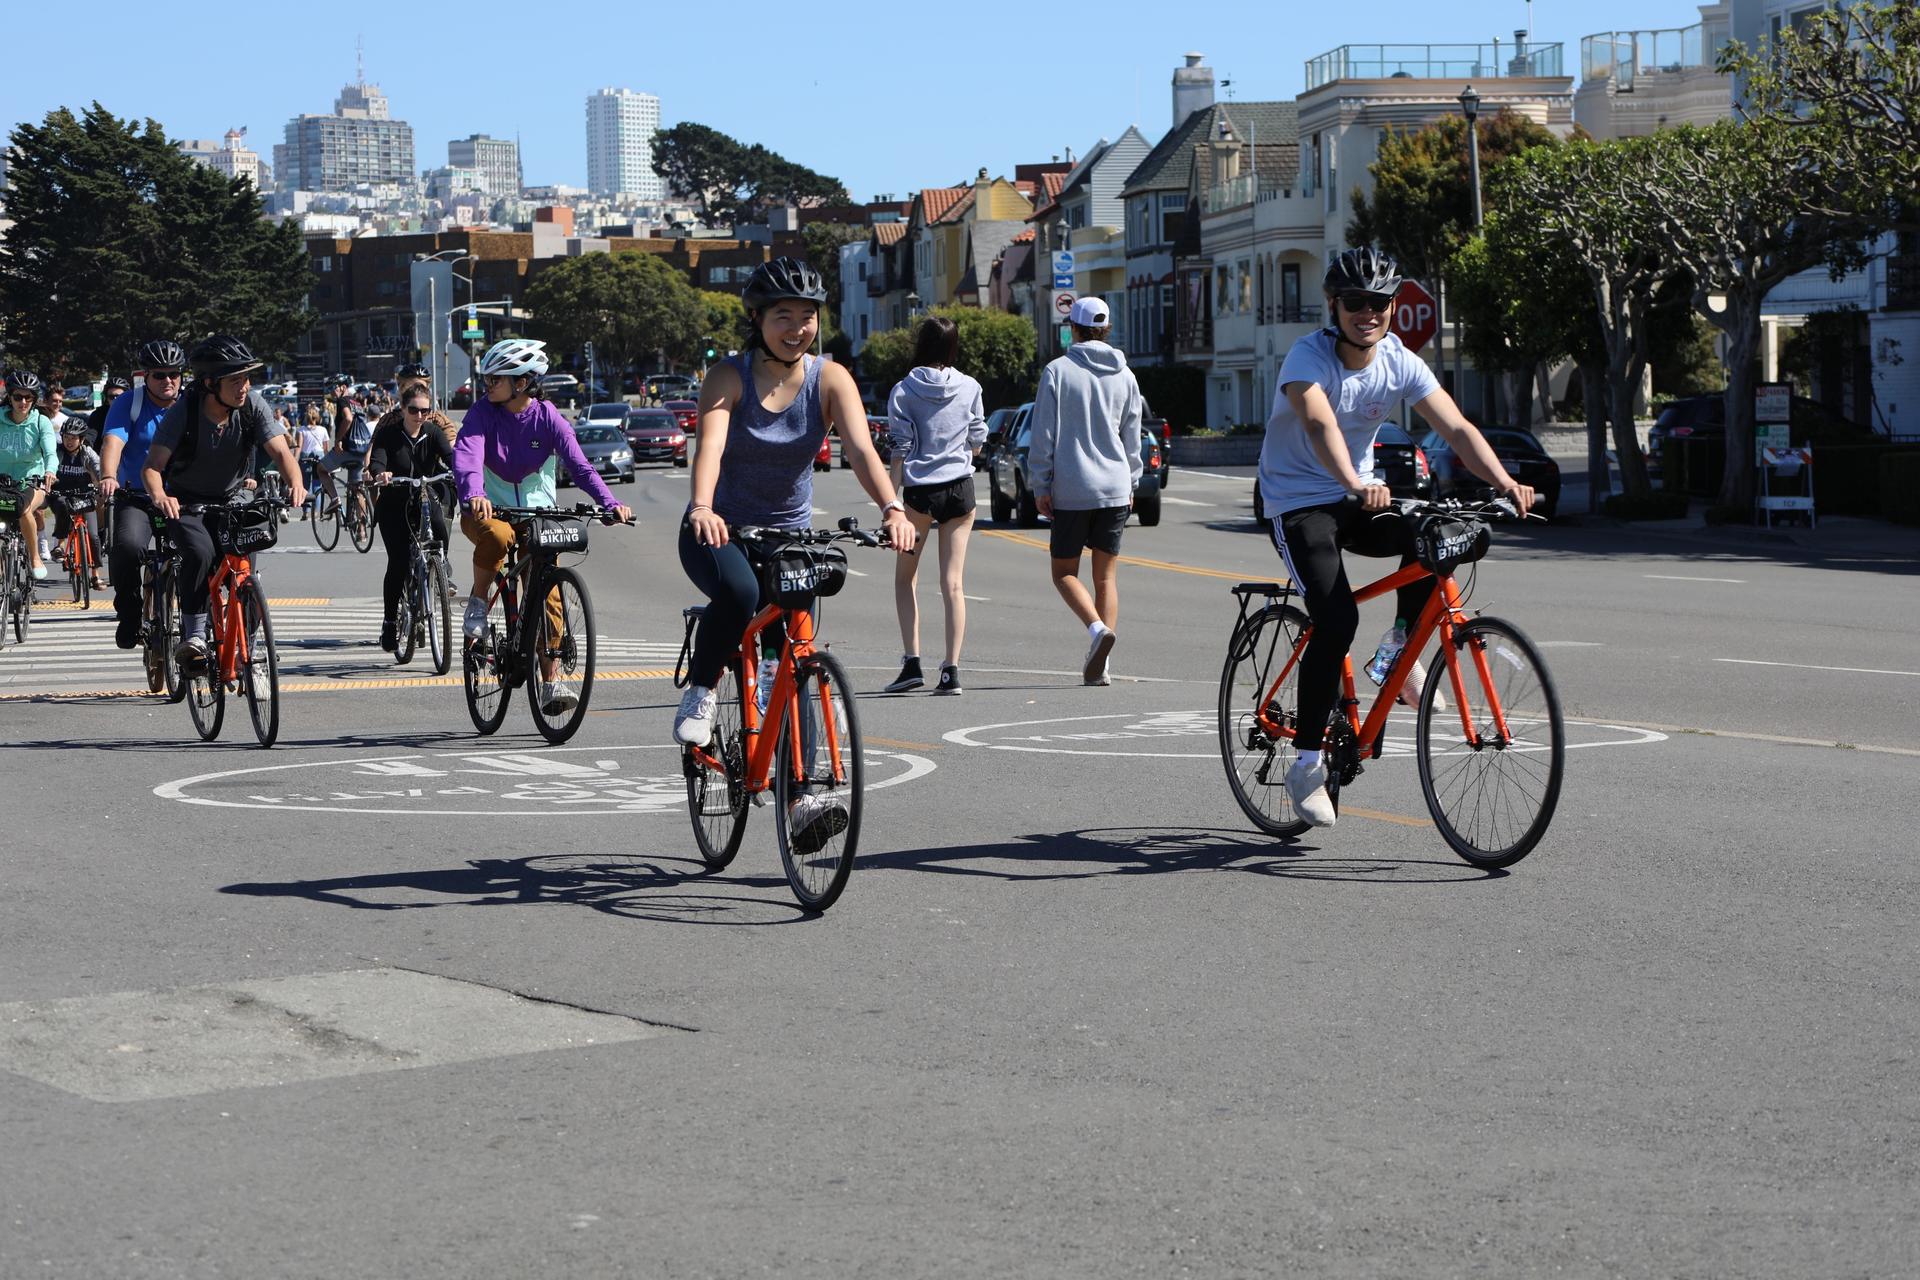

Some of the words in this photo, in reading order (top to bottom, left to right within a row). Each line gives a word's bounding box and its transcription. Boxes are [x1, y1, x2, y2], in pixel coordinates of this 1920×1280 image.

[1397, 303, 1433, 332] OP
[540, 528, 578, 536] UNLIMITED
[540, 534, 579, 544] BIKING
[1438, 541, 1472, 561] BIKI
[248, 786, 495, 803] PATH
